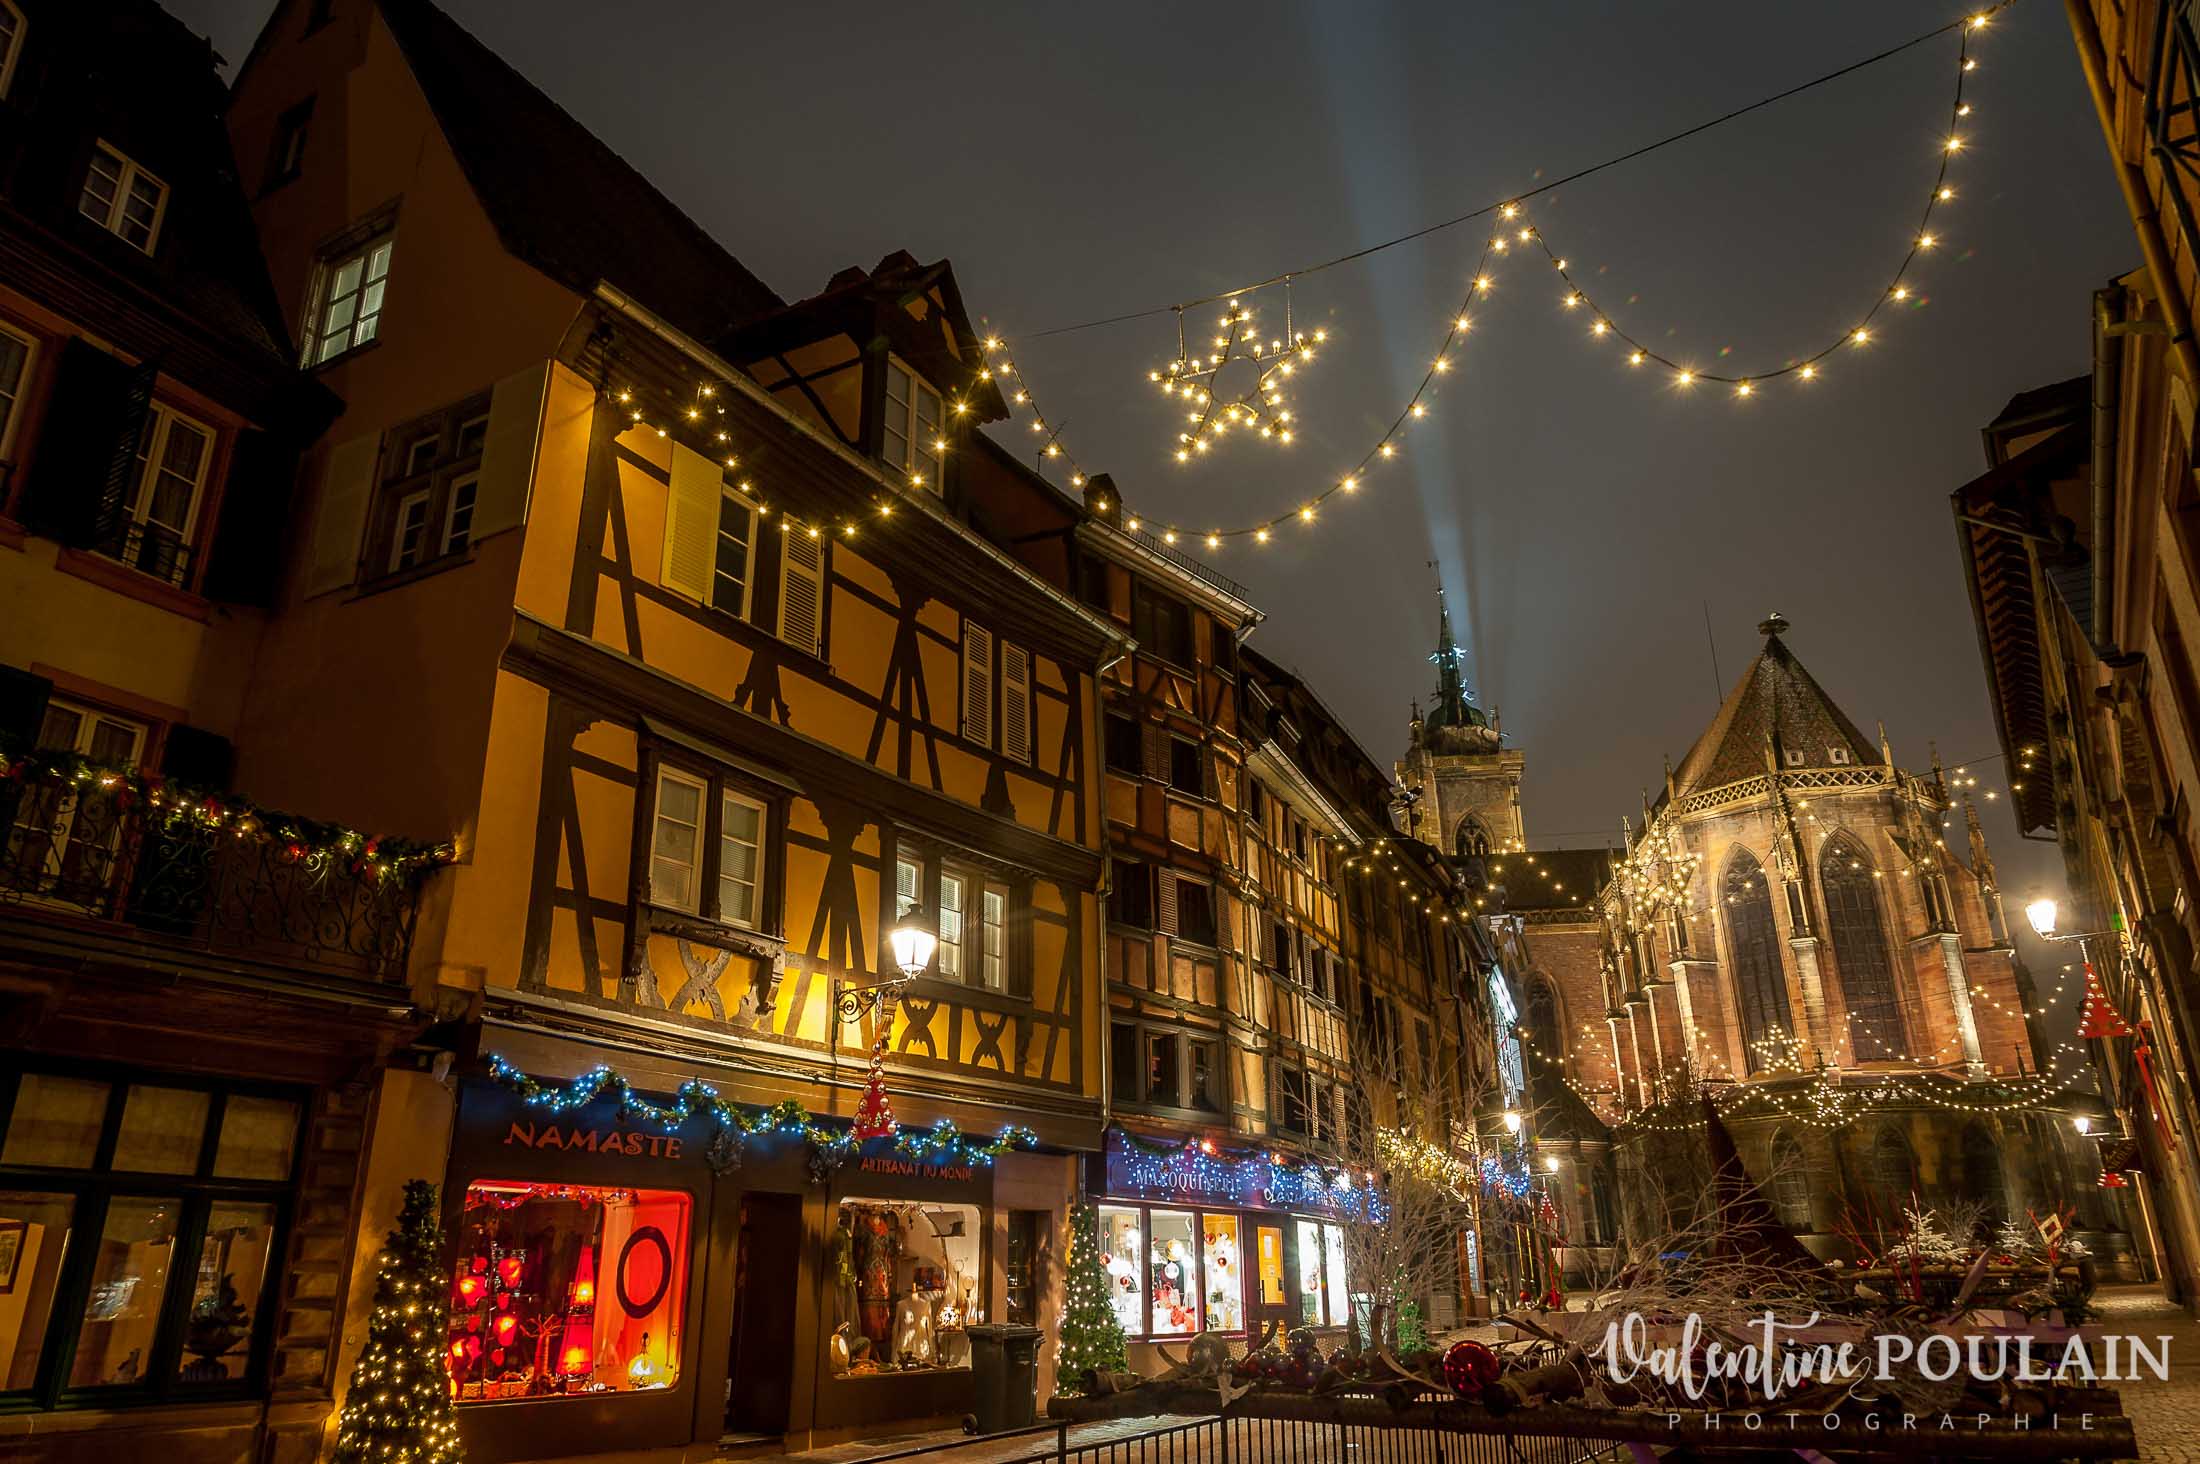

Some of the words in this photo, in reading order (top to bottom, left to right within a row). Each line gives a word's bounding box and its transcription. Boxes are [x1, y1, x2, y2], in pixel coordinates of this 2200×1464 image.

[504, 1121, 682, 1158] NAMASTE
[860, 1157, 920, 1176] ARTISANAT
[923, 1166, 937, 1177] DU
[940, 1168, 974, 1182] MONDE
